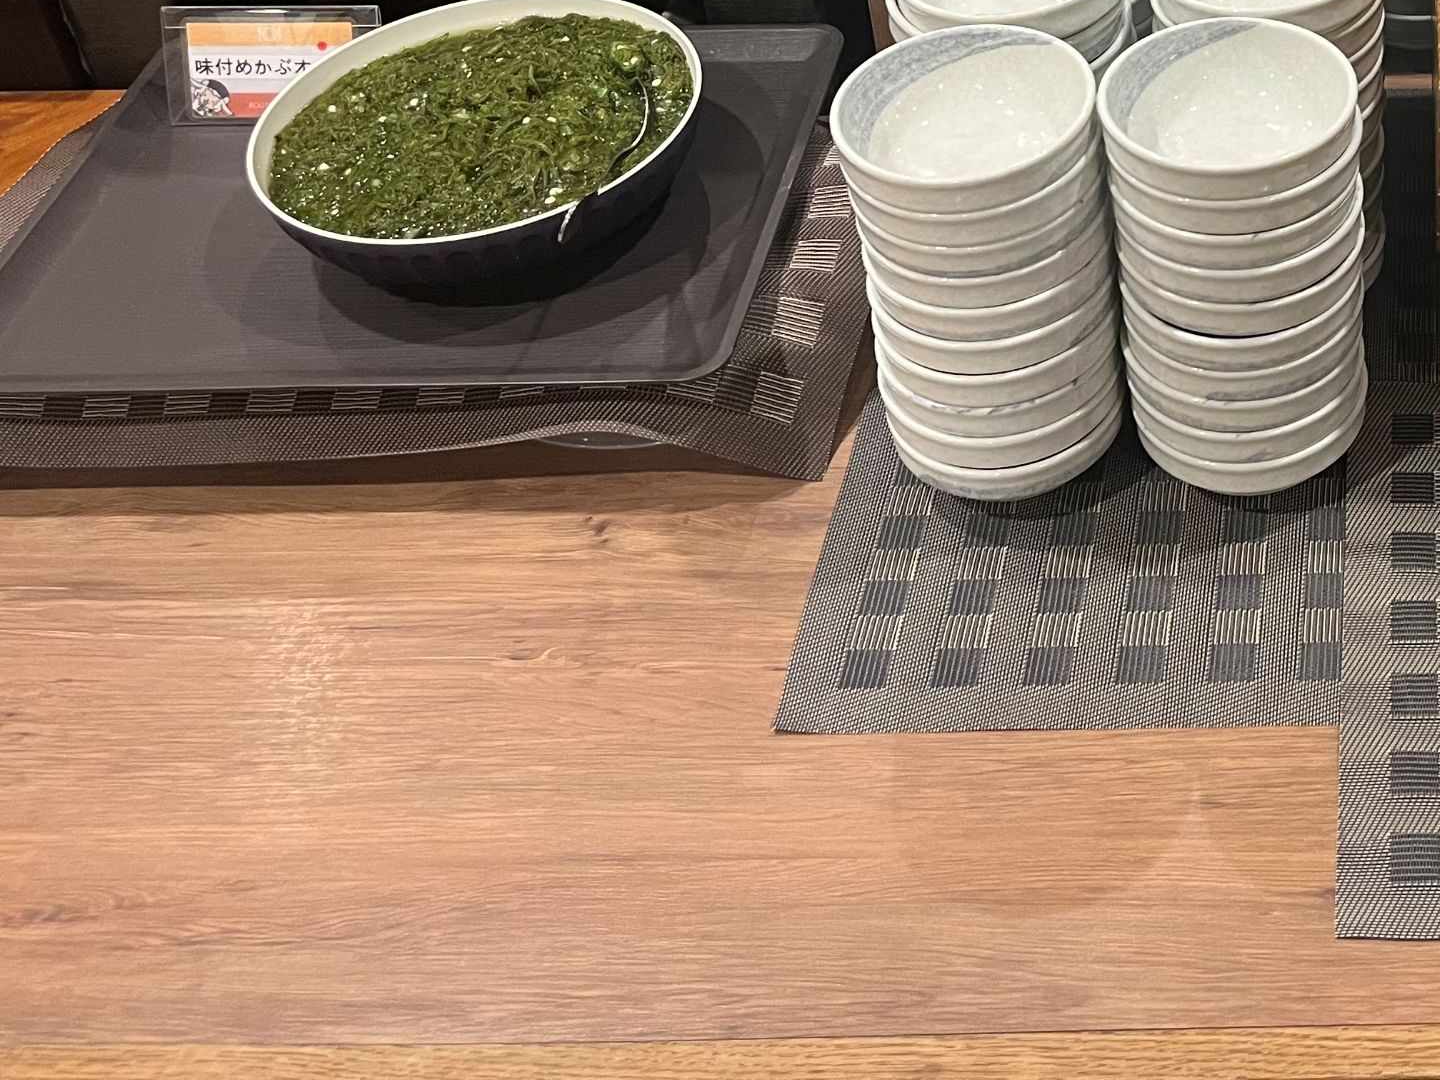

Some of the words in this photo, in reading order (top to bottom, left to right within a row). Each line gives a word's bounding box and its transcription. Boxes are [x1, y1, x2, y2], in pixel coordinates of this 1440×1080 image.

[195, 58, 311, 76] 味付めかぶオ
